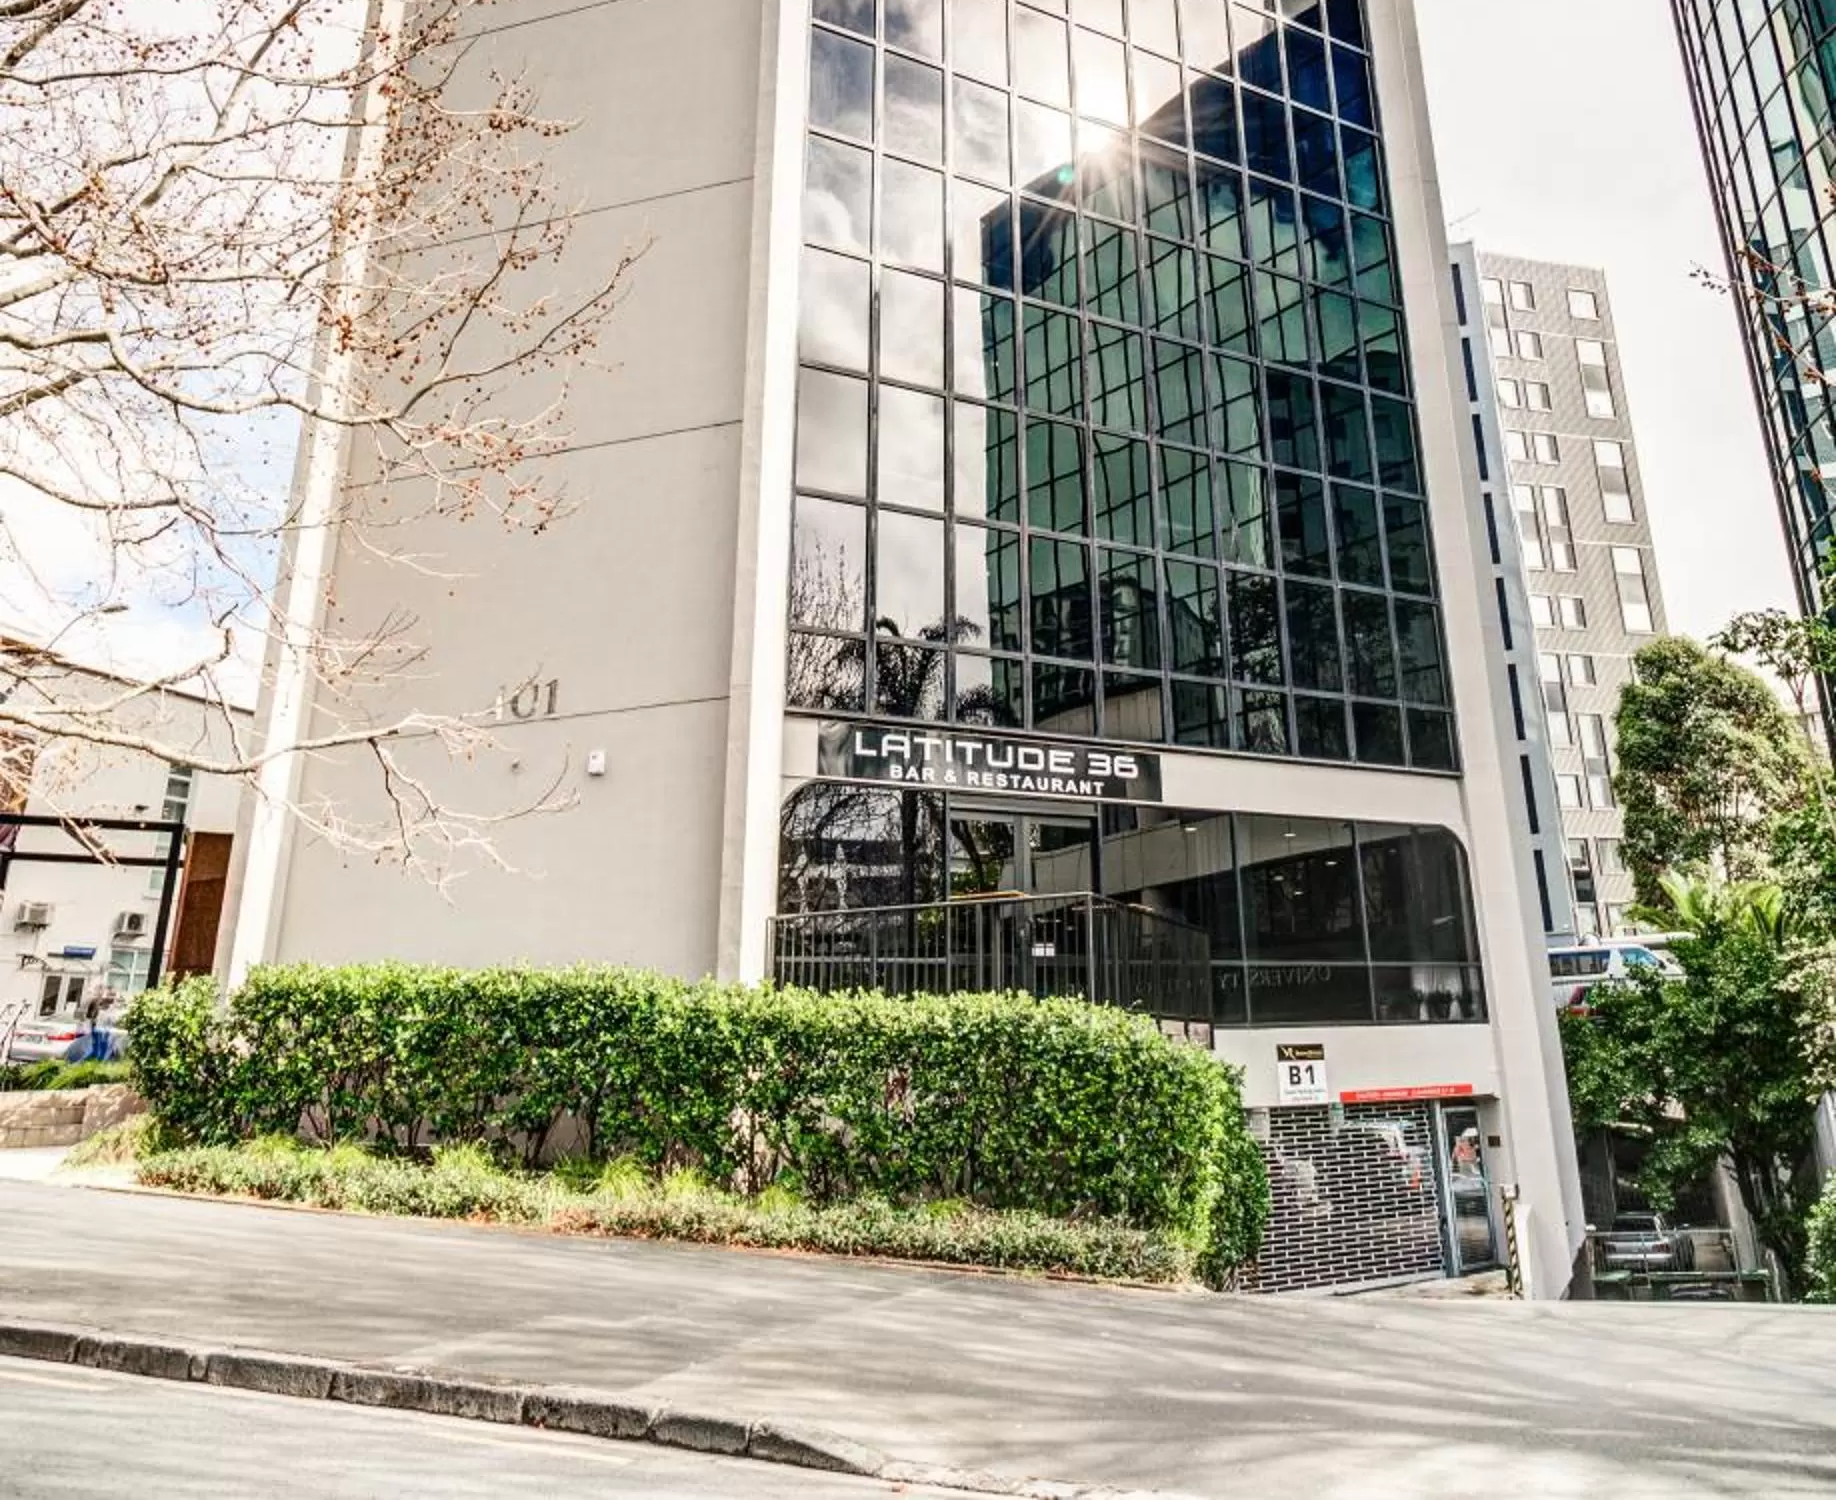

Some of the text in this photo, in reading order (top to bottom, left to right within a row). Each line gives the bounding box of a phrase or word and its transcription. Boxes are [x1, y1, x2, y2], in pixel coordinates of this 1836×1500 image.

[854, 731, 1139, 779] LATITUDE 36
[889, 765, 1105, 796] BAR & RESTAURANT
[1288, 1064, 1316, 1086] B1
